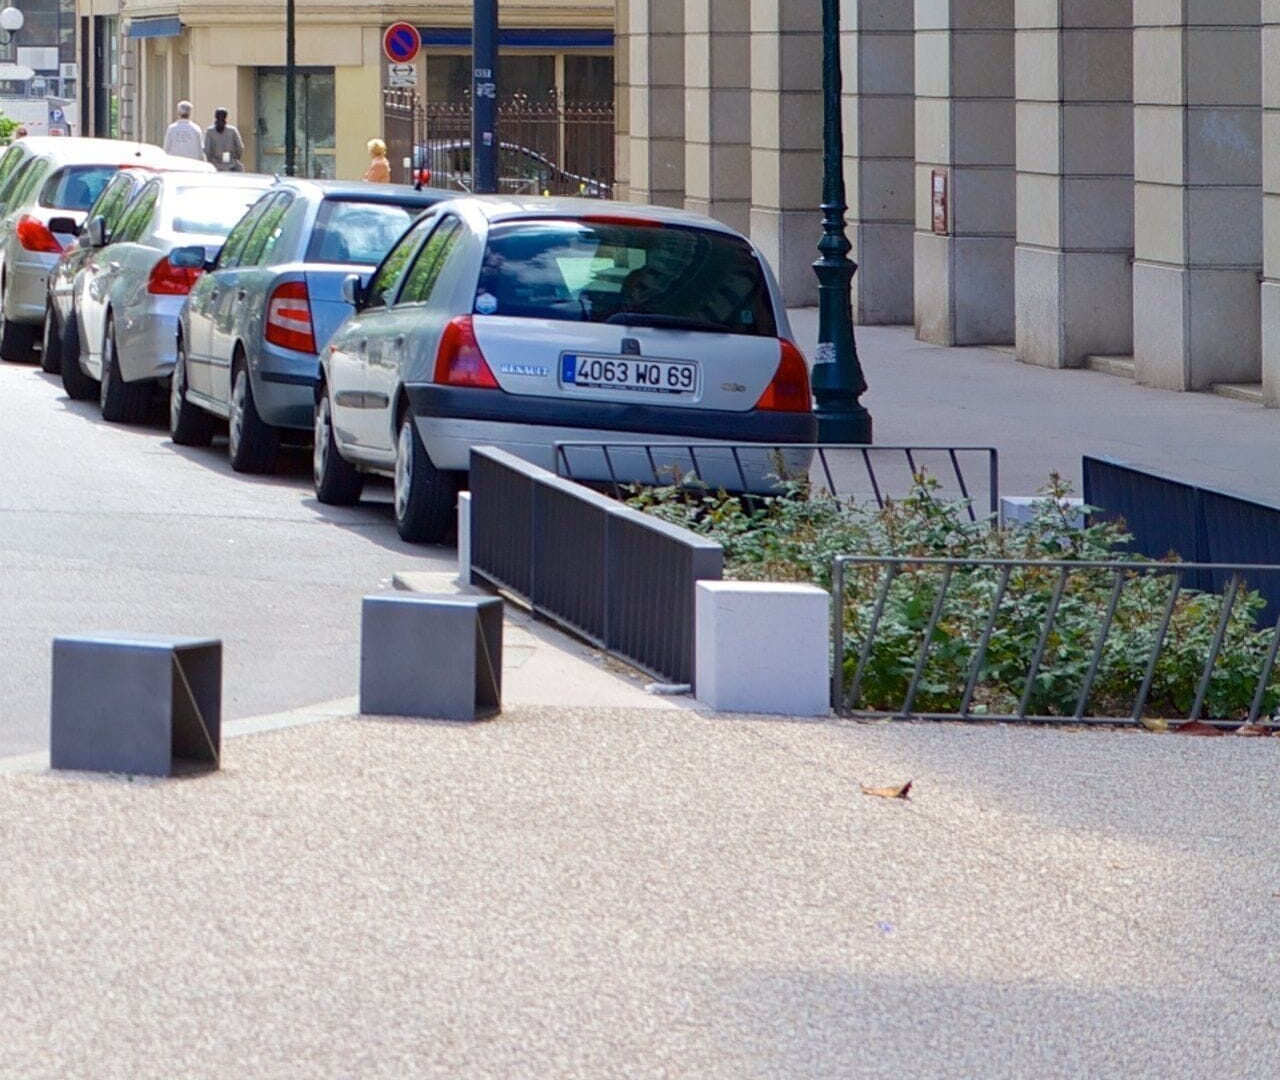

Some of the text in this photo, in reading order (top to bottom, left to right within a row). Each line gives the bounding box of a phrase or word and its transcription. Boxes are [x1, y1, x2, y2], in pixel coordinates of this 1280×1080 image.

[53, 109, 62, 120] P
[576, 359, 693, 387] 4063 WQ 69
